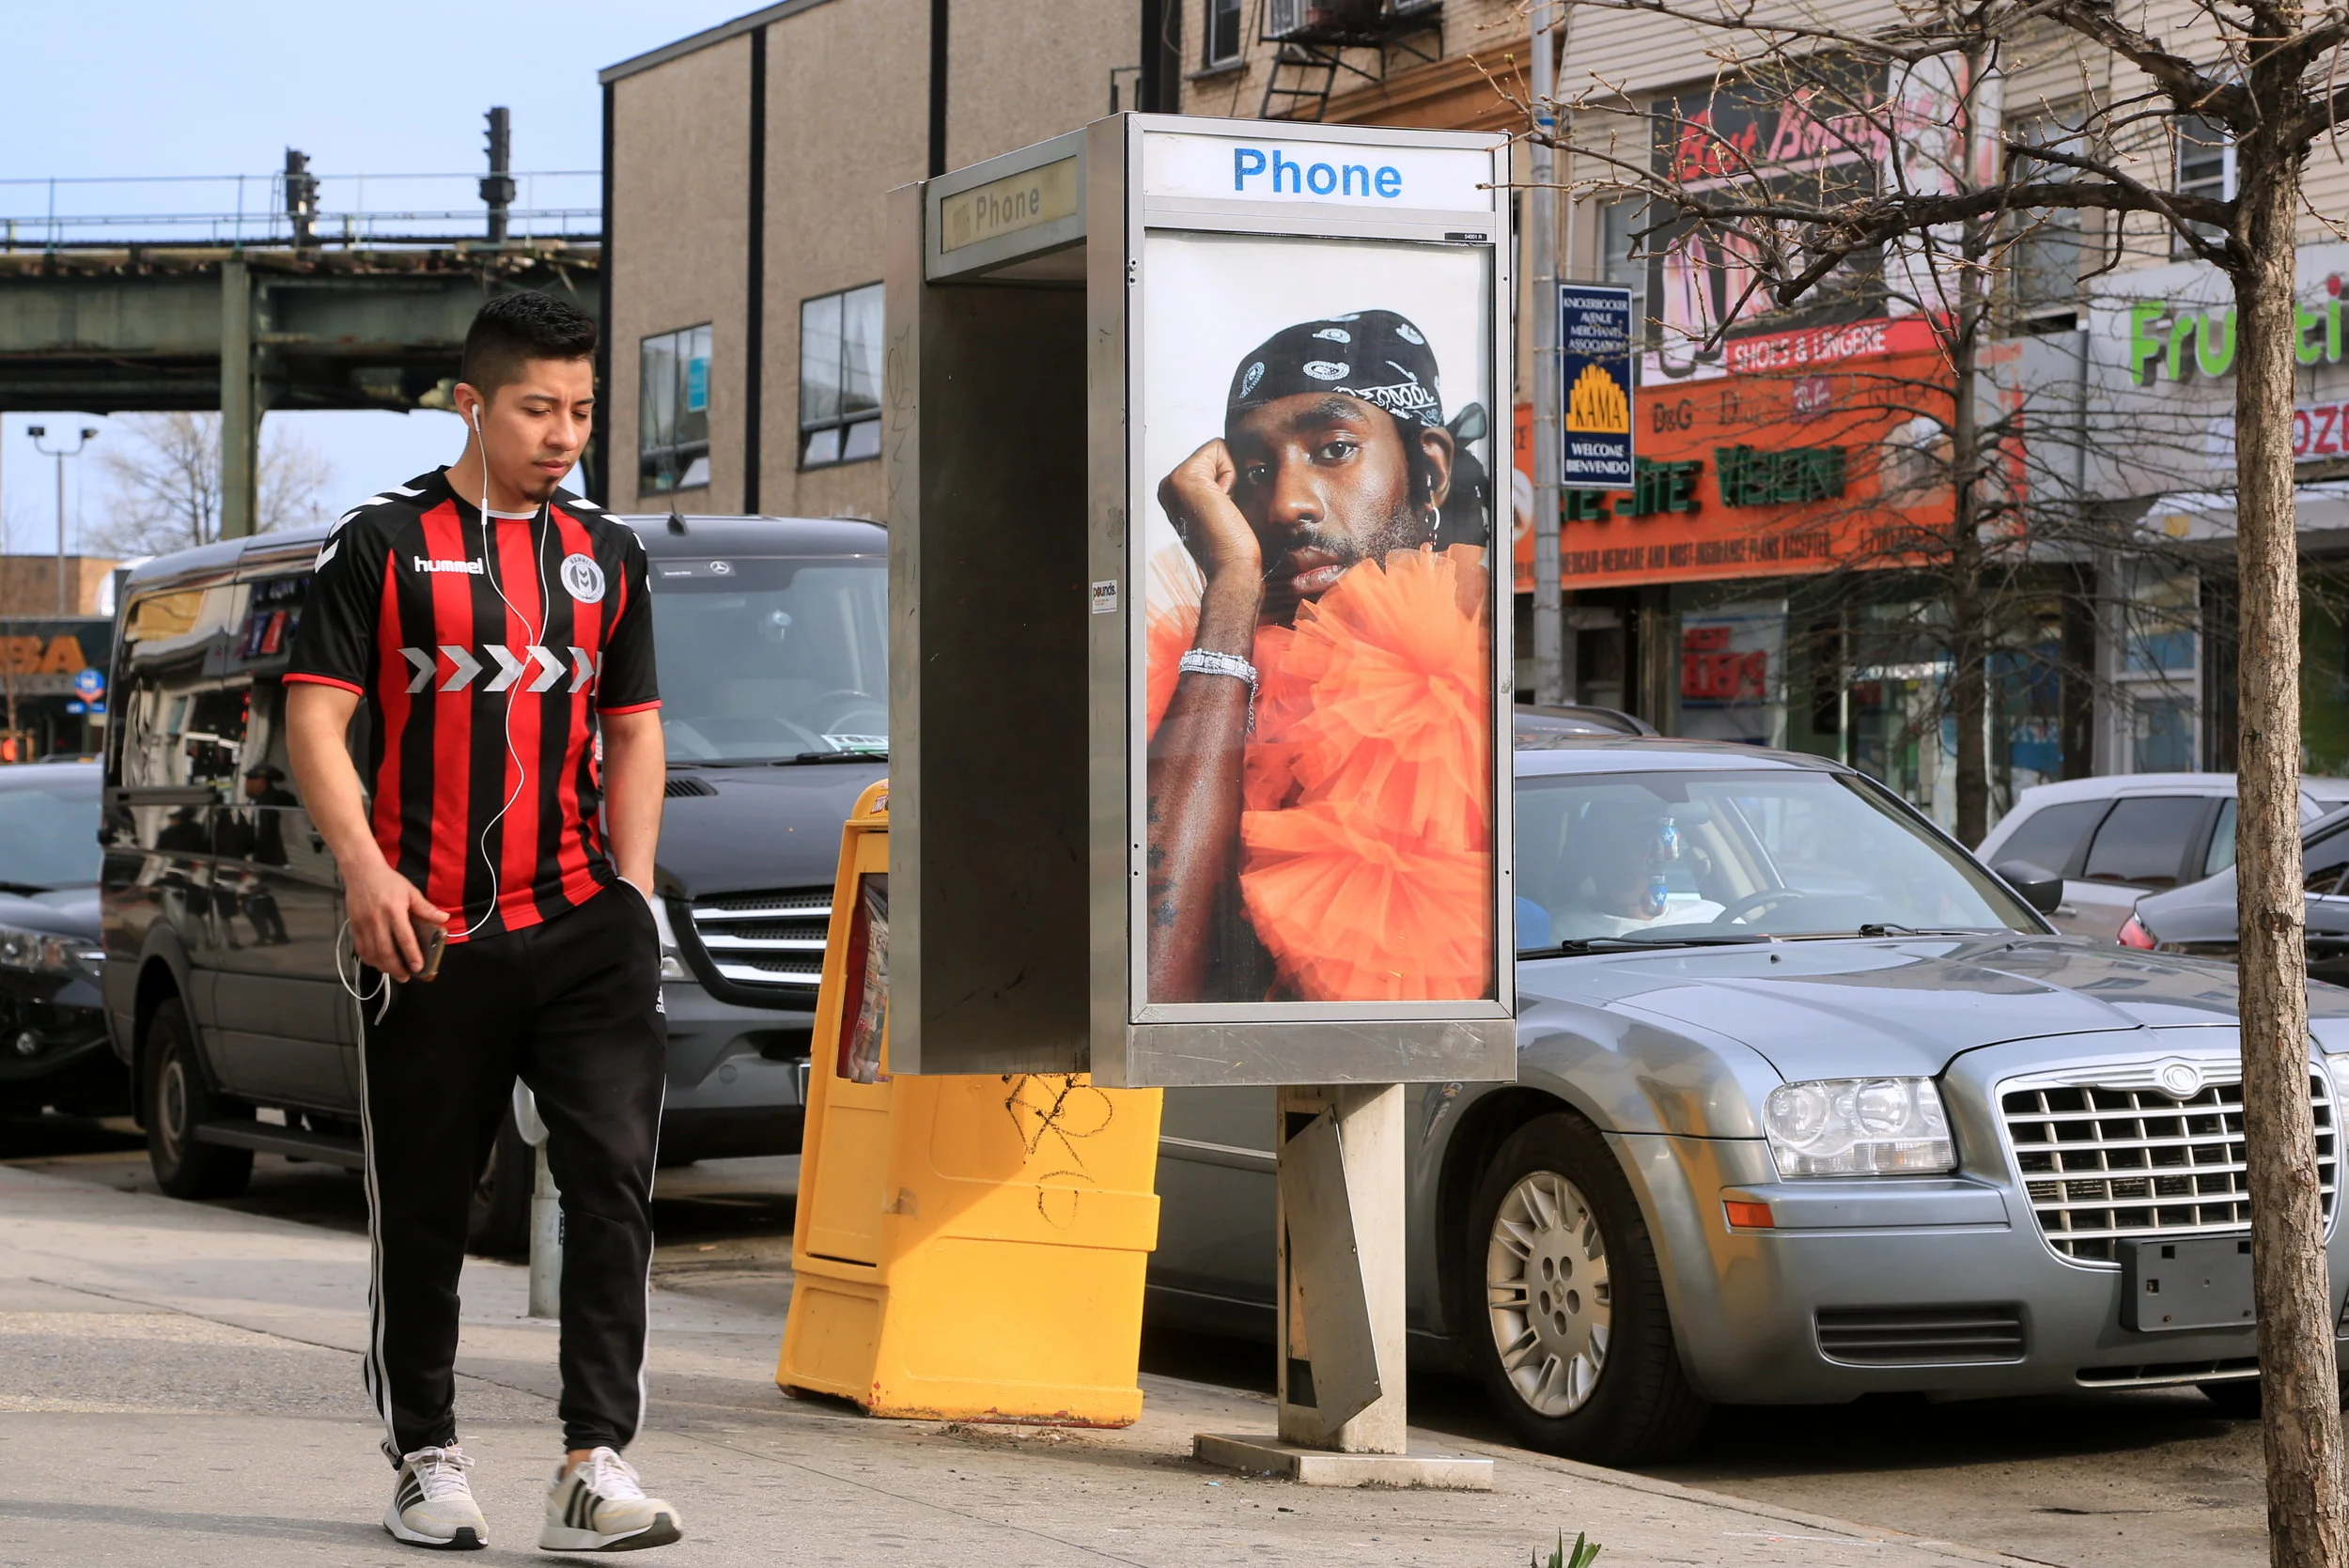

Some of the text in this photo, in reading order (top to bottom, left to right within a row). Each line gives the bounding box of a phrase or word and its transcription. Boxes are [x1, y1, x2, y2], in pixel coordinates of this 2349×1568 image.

[1234, 147, 1403, 198] Phone
[975, 189, 1040, 232] Phone
[1580, 311, 1612, 325] AVENUE
[1735, 324, 1887, 371] SHOES & LINGERIE
[1575, 387, 1622, 429] KAMA
[1571, 442, 1625, 458] WELCOME
[1565, 458, 1629, 475] BIENVENIDO
[413, 556, 484, 575] hummel
